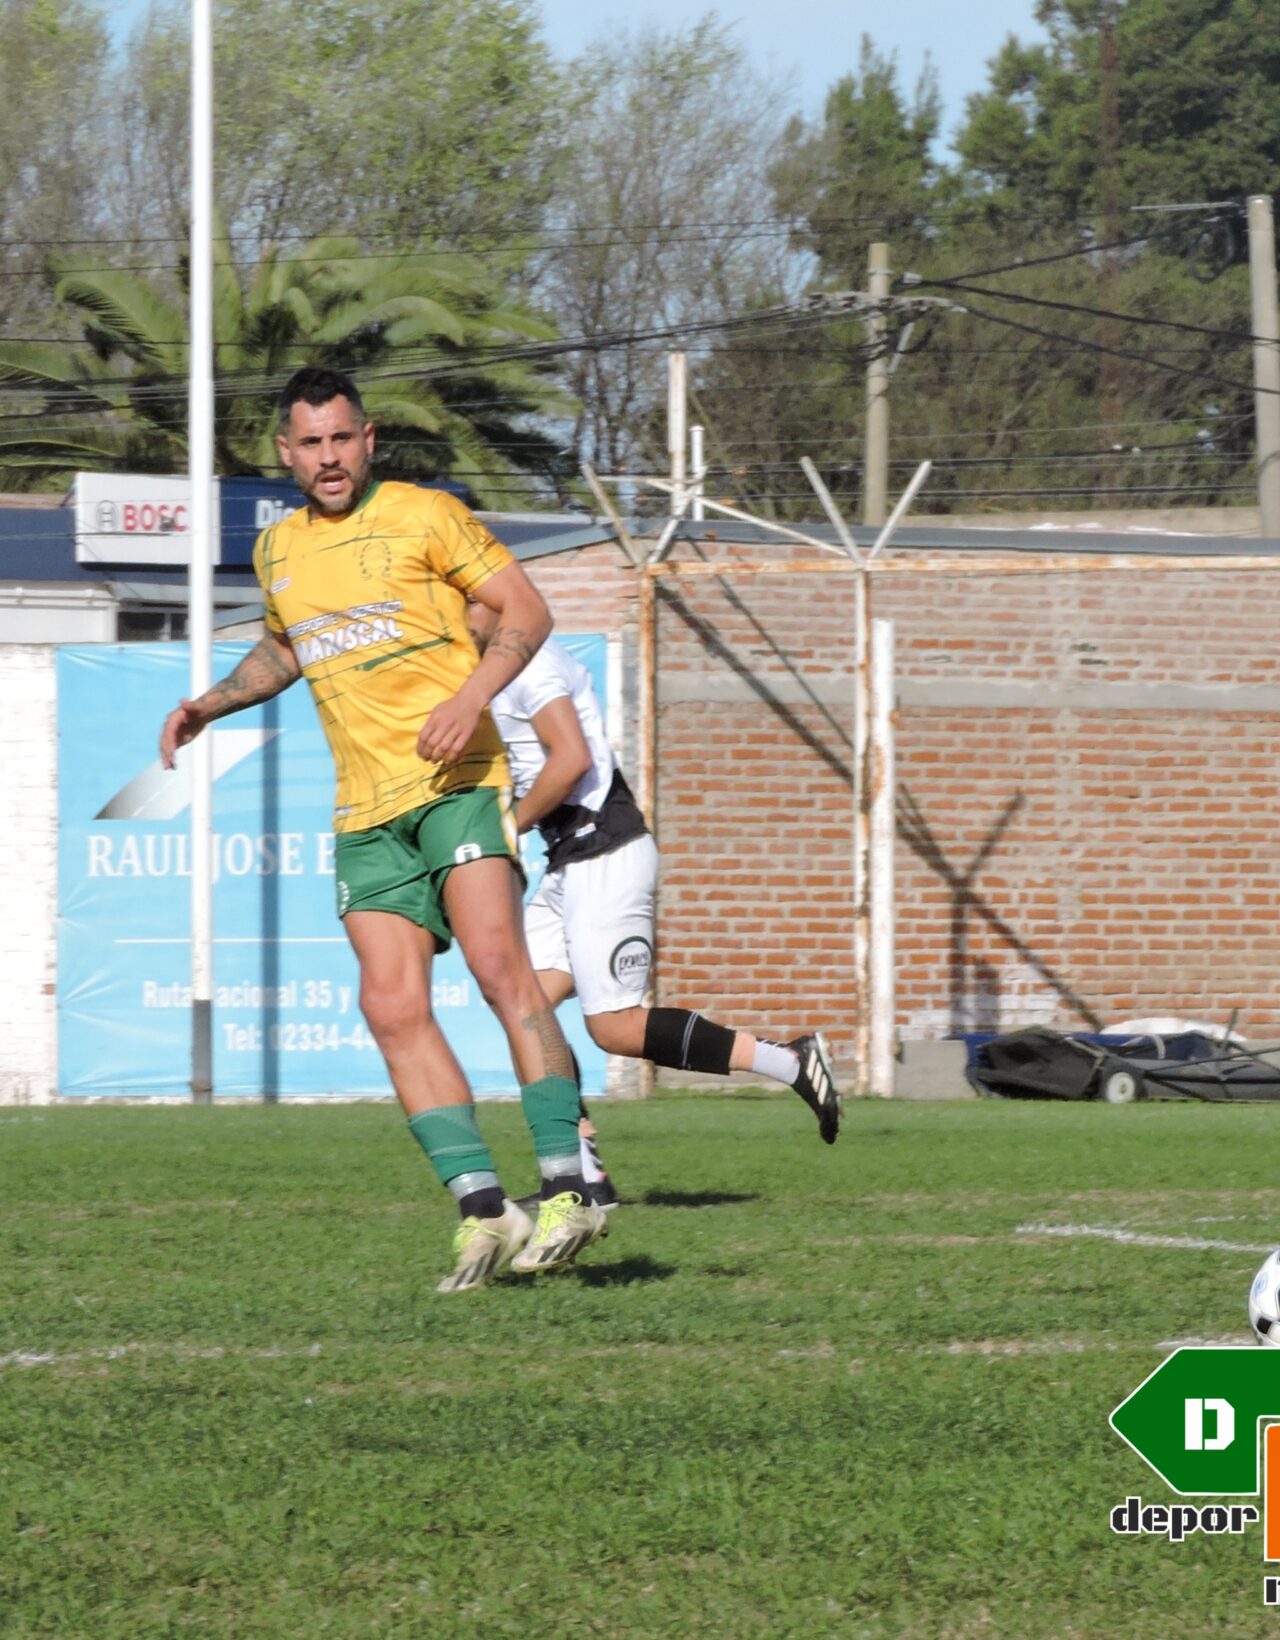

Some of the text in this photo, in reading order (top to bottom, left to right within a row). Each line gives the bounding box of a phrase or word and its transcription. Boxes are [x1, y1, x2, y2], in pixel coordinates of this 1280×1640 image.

[123, 502, 188, 532] BOSC
[88, 833, 193, 878] RAUL
[210, 832, 304, 885] JOSE
[143, 980, 193, 1009] Ruta
[213, 980, 297, 1009] acional
[303, 980, 333, 1009] 35
[337, 986, 352, 1014] y
[223, 1023, 263, 1051] Tel:
